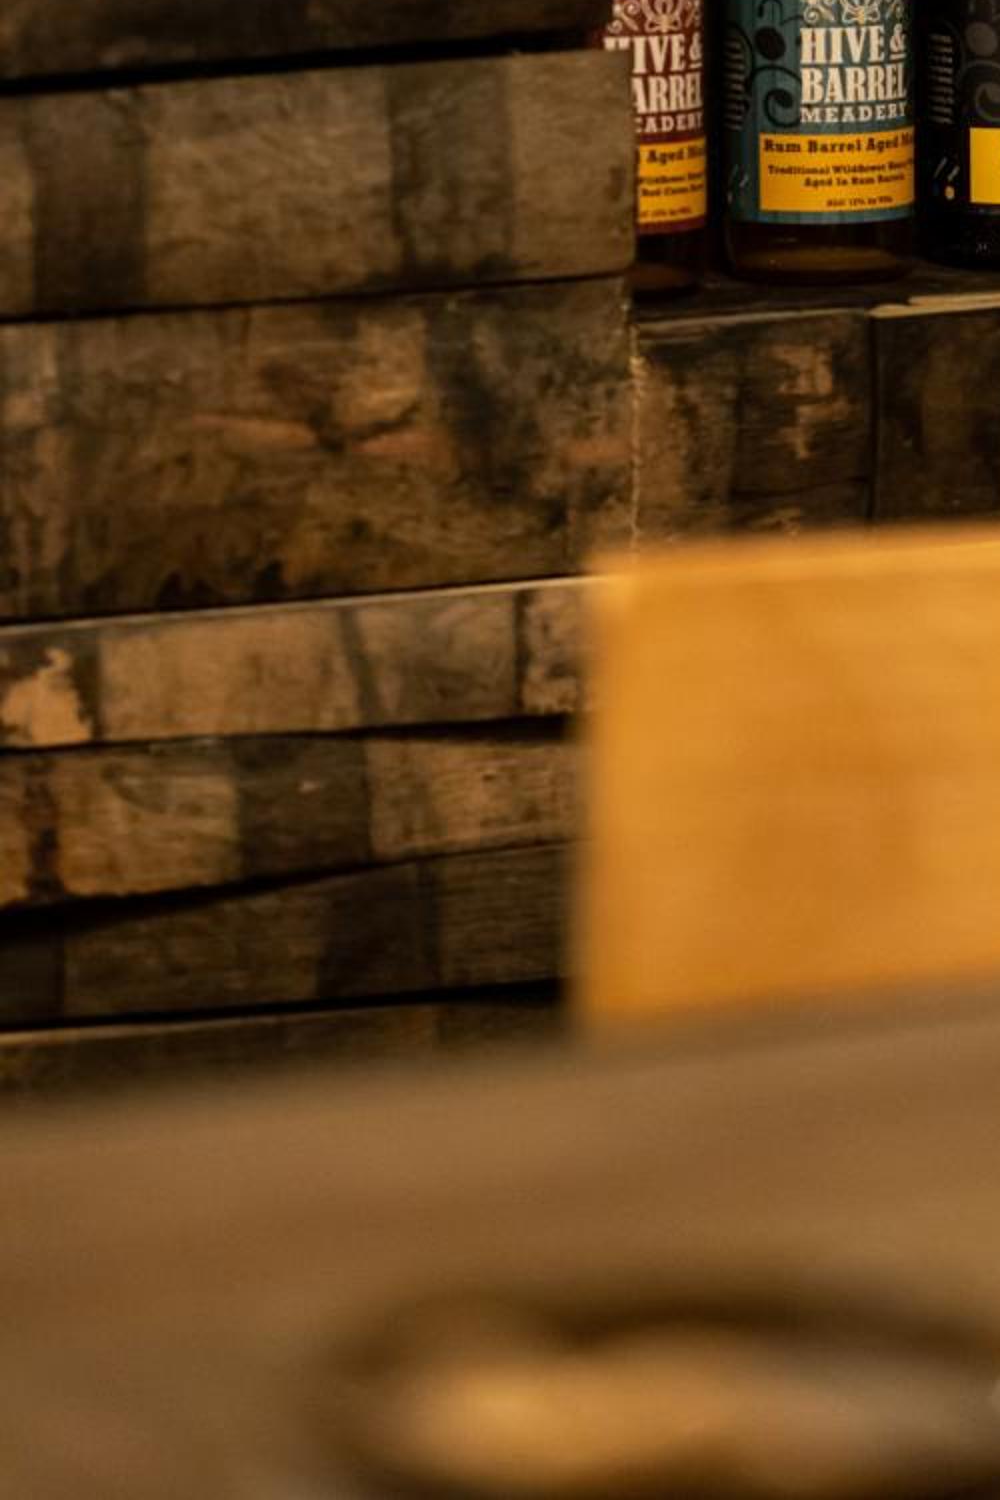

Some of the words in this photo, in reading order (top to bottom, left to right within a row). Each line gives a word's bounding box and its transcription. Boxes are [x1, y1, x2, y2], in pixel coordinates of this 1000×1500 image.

[603, 35, 686, 74] IVE
[800, 25, 885, 64] HIVE
[889, 23, 906, 59] &
[631, 71, 703, 115] ARREL
[800, 63, 907, 103] BARREL
[800, 102, 907, 123] MEADERY
[764, 138, 801, 152] Rum
[807, 139, 861, 154] Barrel
